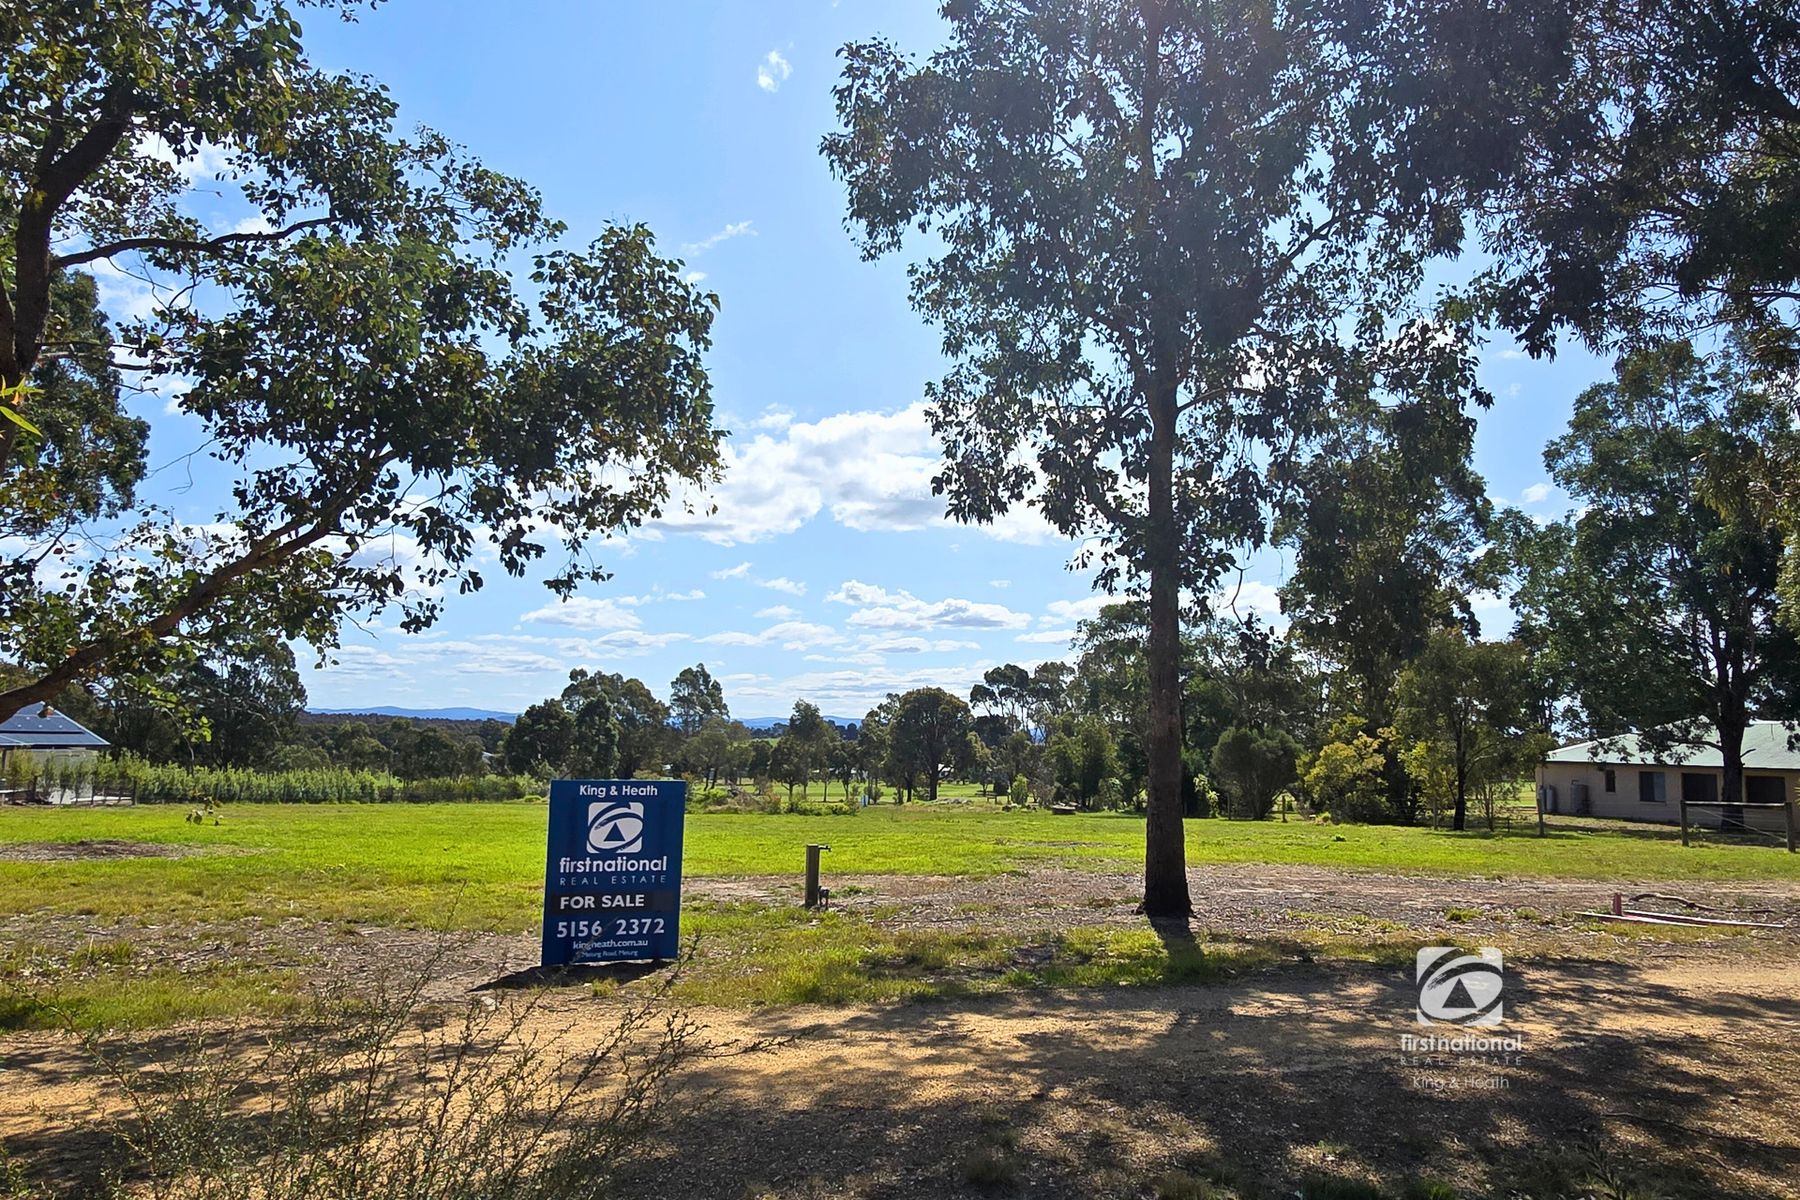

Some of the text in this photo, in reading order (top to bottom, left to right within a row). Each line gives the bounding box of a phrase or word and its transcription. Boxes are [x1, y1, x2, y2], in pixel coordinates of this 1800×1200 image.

[580, 785, 657, 797] King & Heath
[560, 856, 667, 873] firstnational
[560, 875, 666, 885] REAL ESTATE
[560, 894, 644, 909] FOR SALE
[557, 918, 665, 938] 5156 2372
